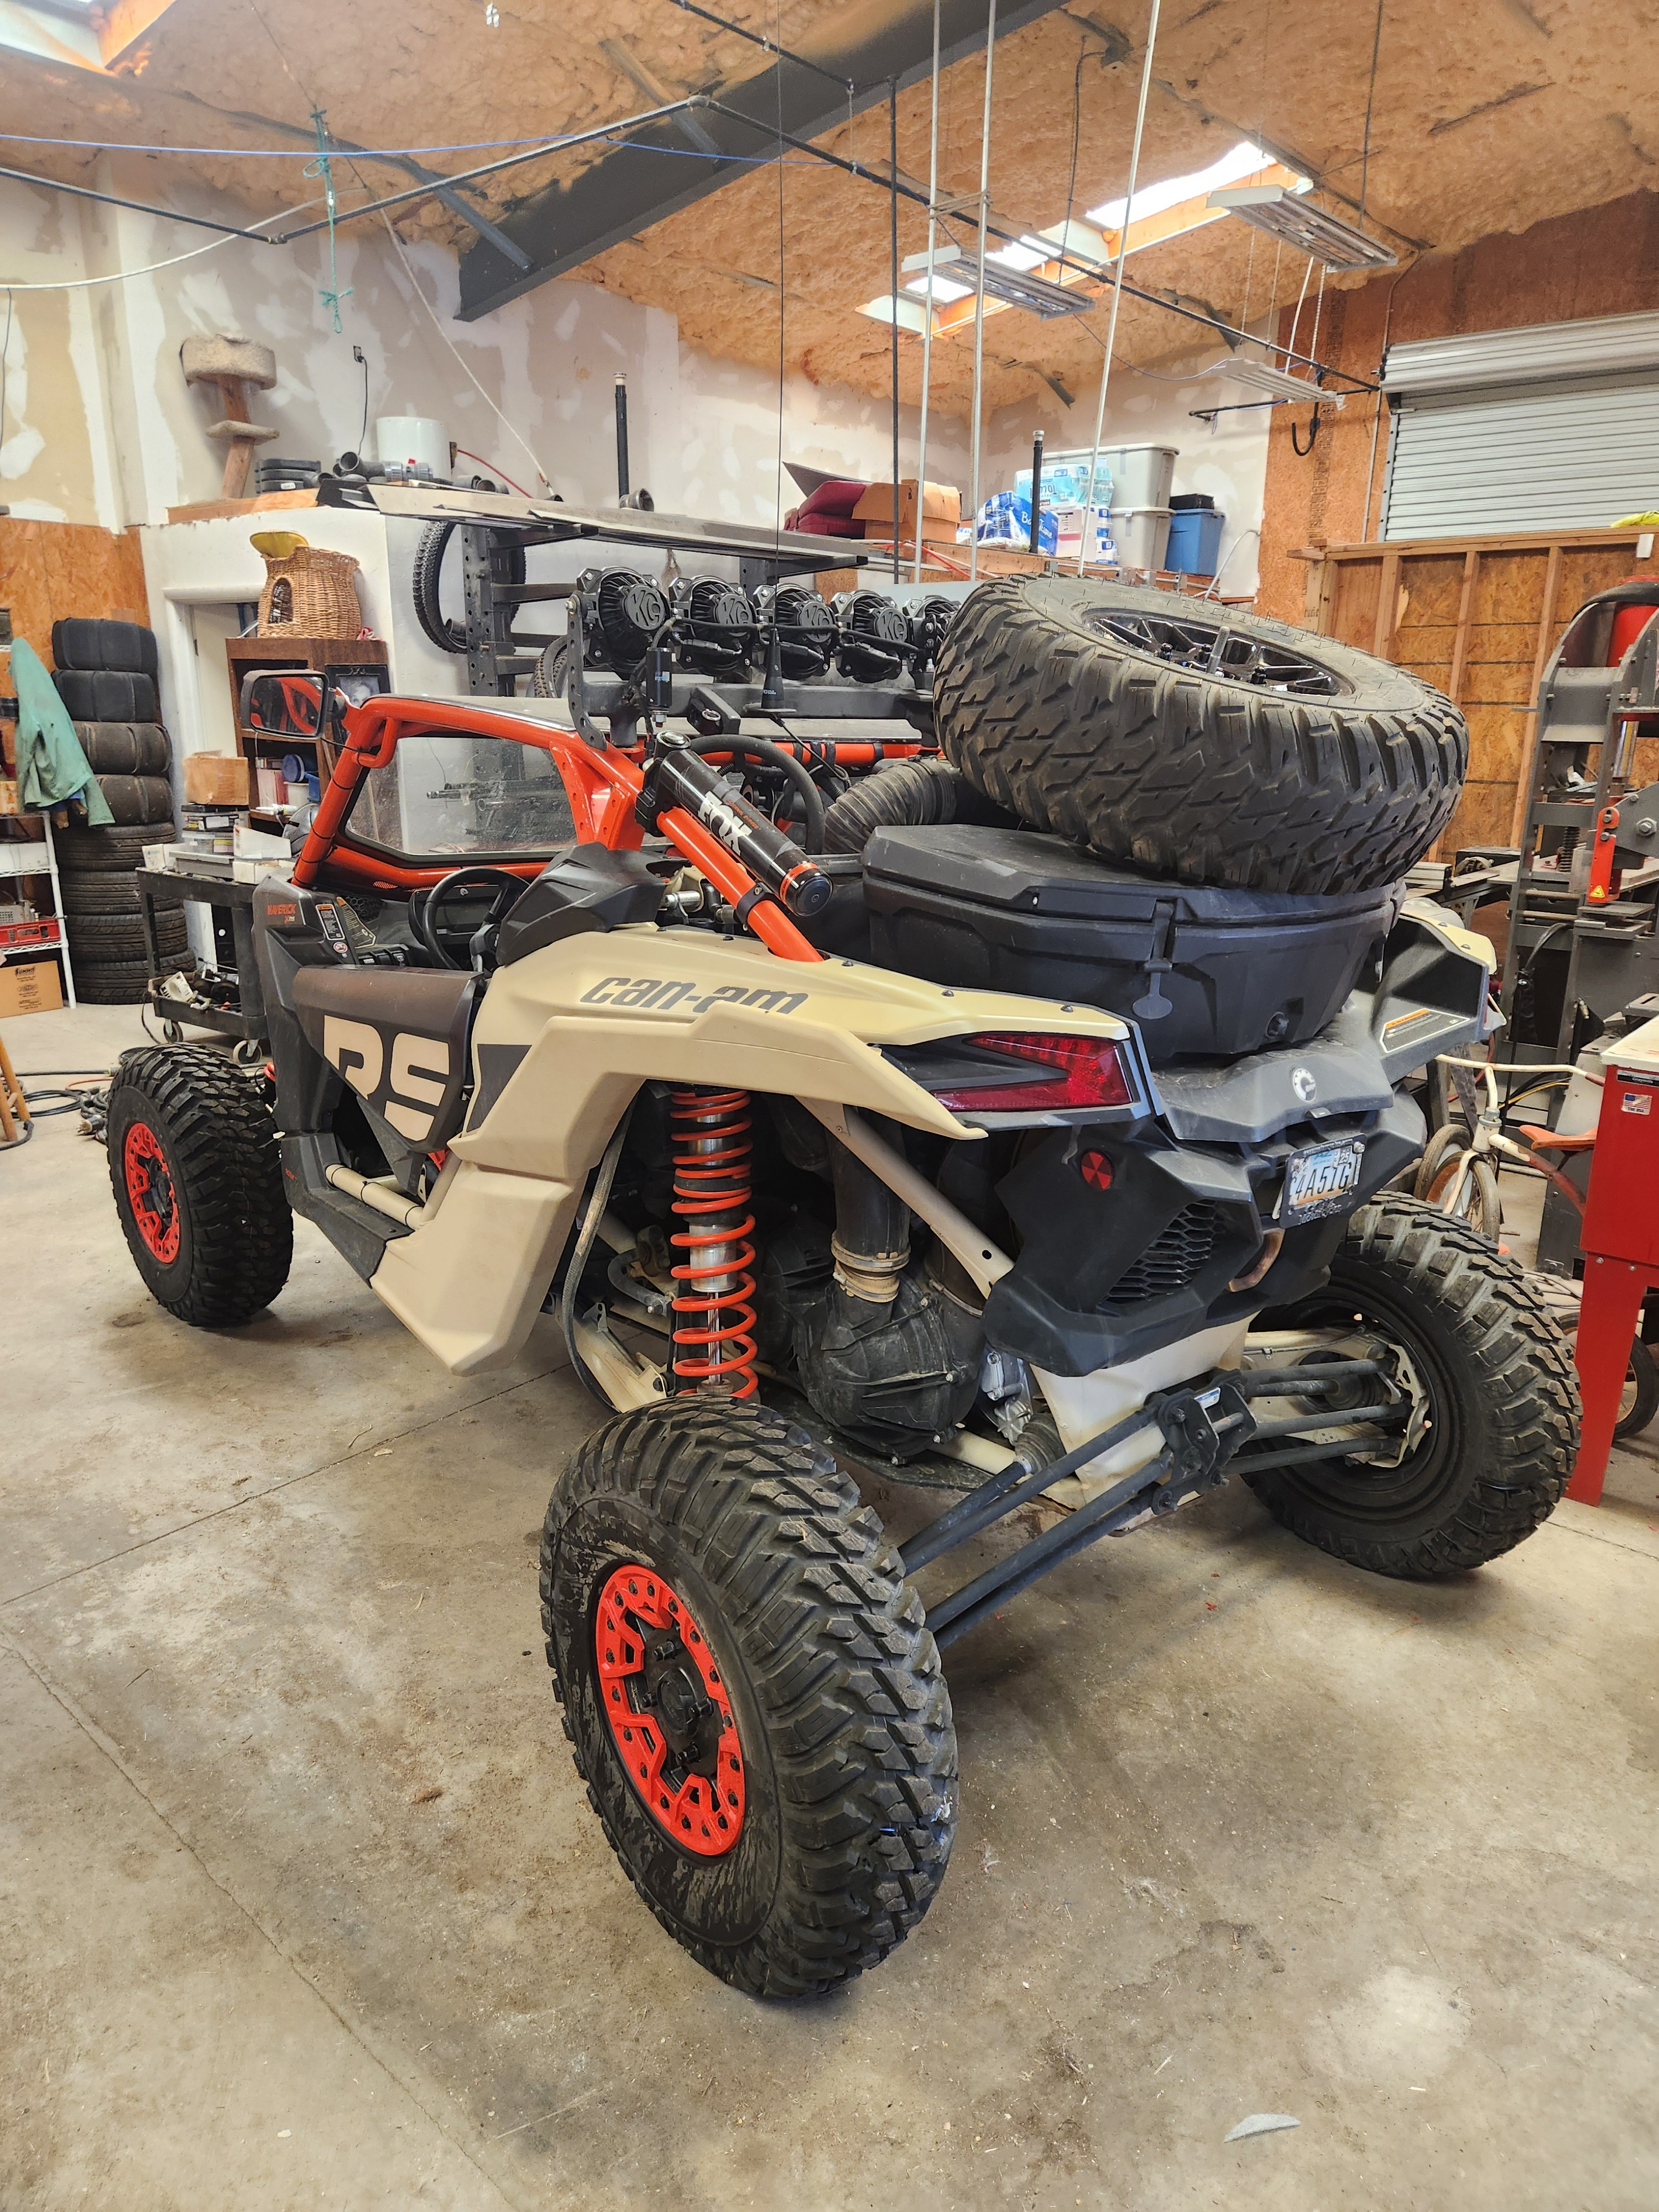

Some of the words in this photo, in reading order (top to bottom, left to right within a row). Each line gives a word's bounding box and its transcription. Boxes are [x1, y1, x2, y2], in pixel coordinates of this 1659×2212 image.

[698, 790, 753, 856] FOX
[580, 977, 809, 1015] can-am
[324, 1014, 450, 1141] RS
[1340, 1152, 1349, 1164] 25
[1292, 1162, 1352, 1201] 4A51G
